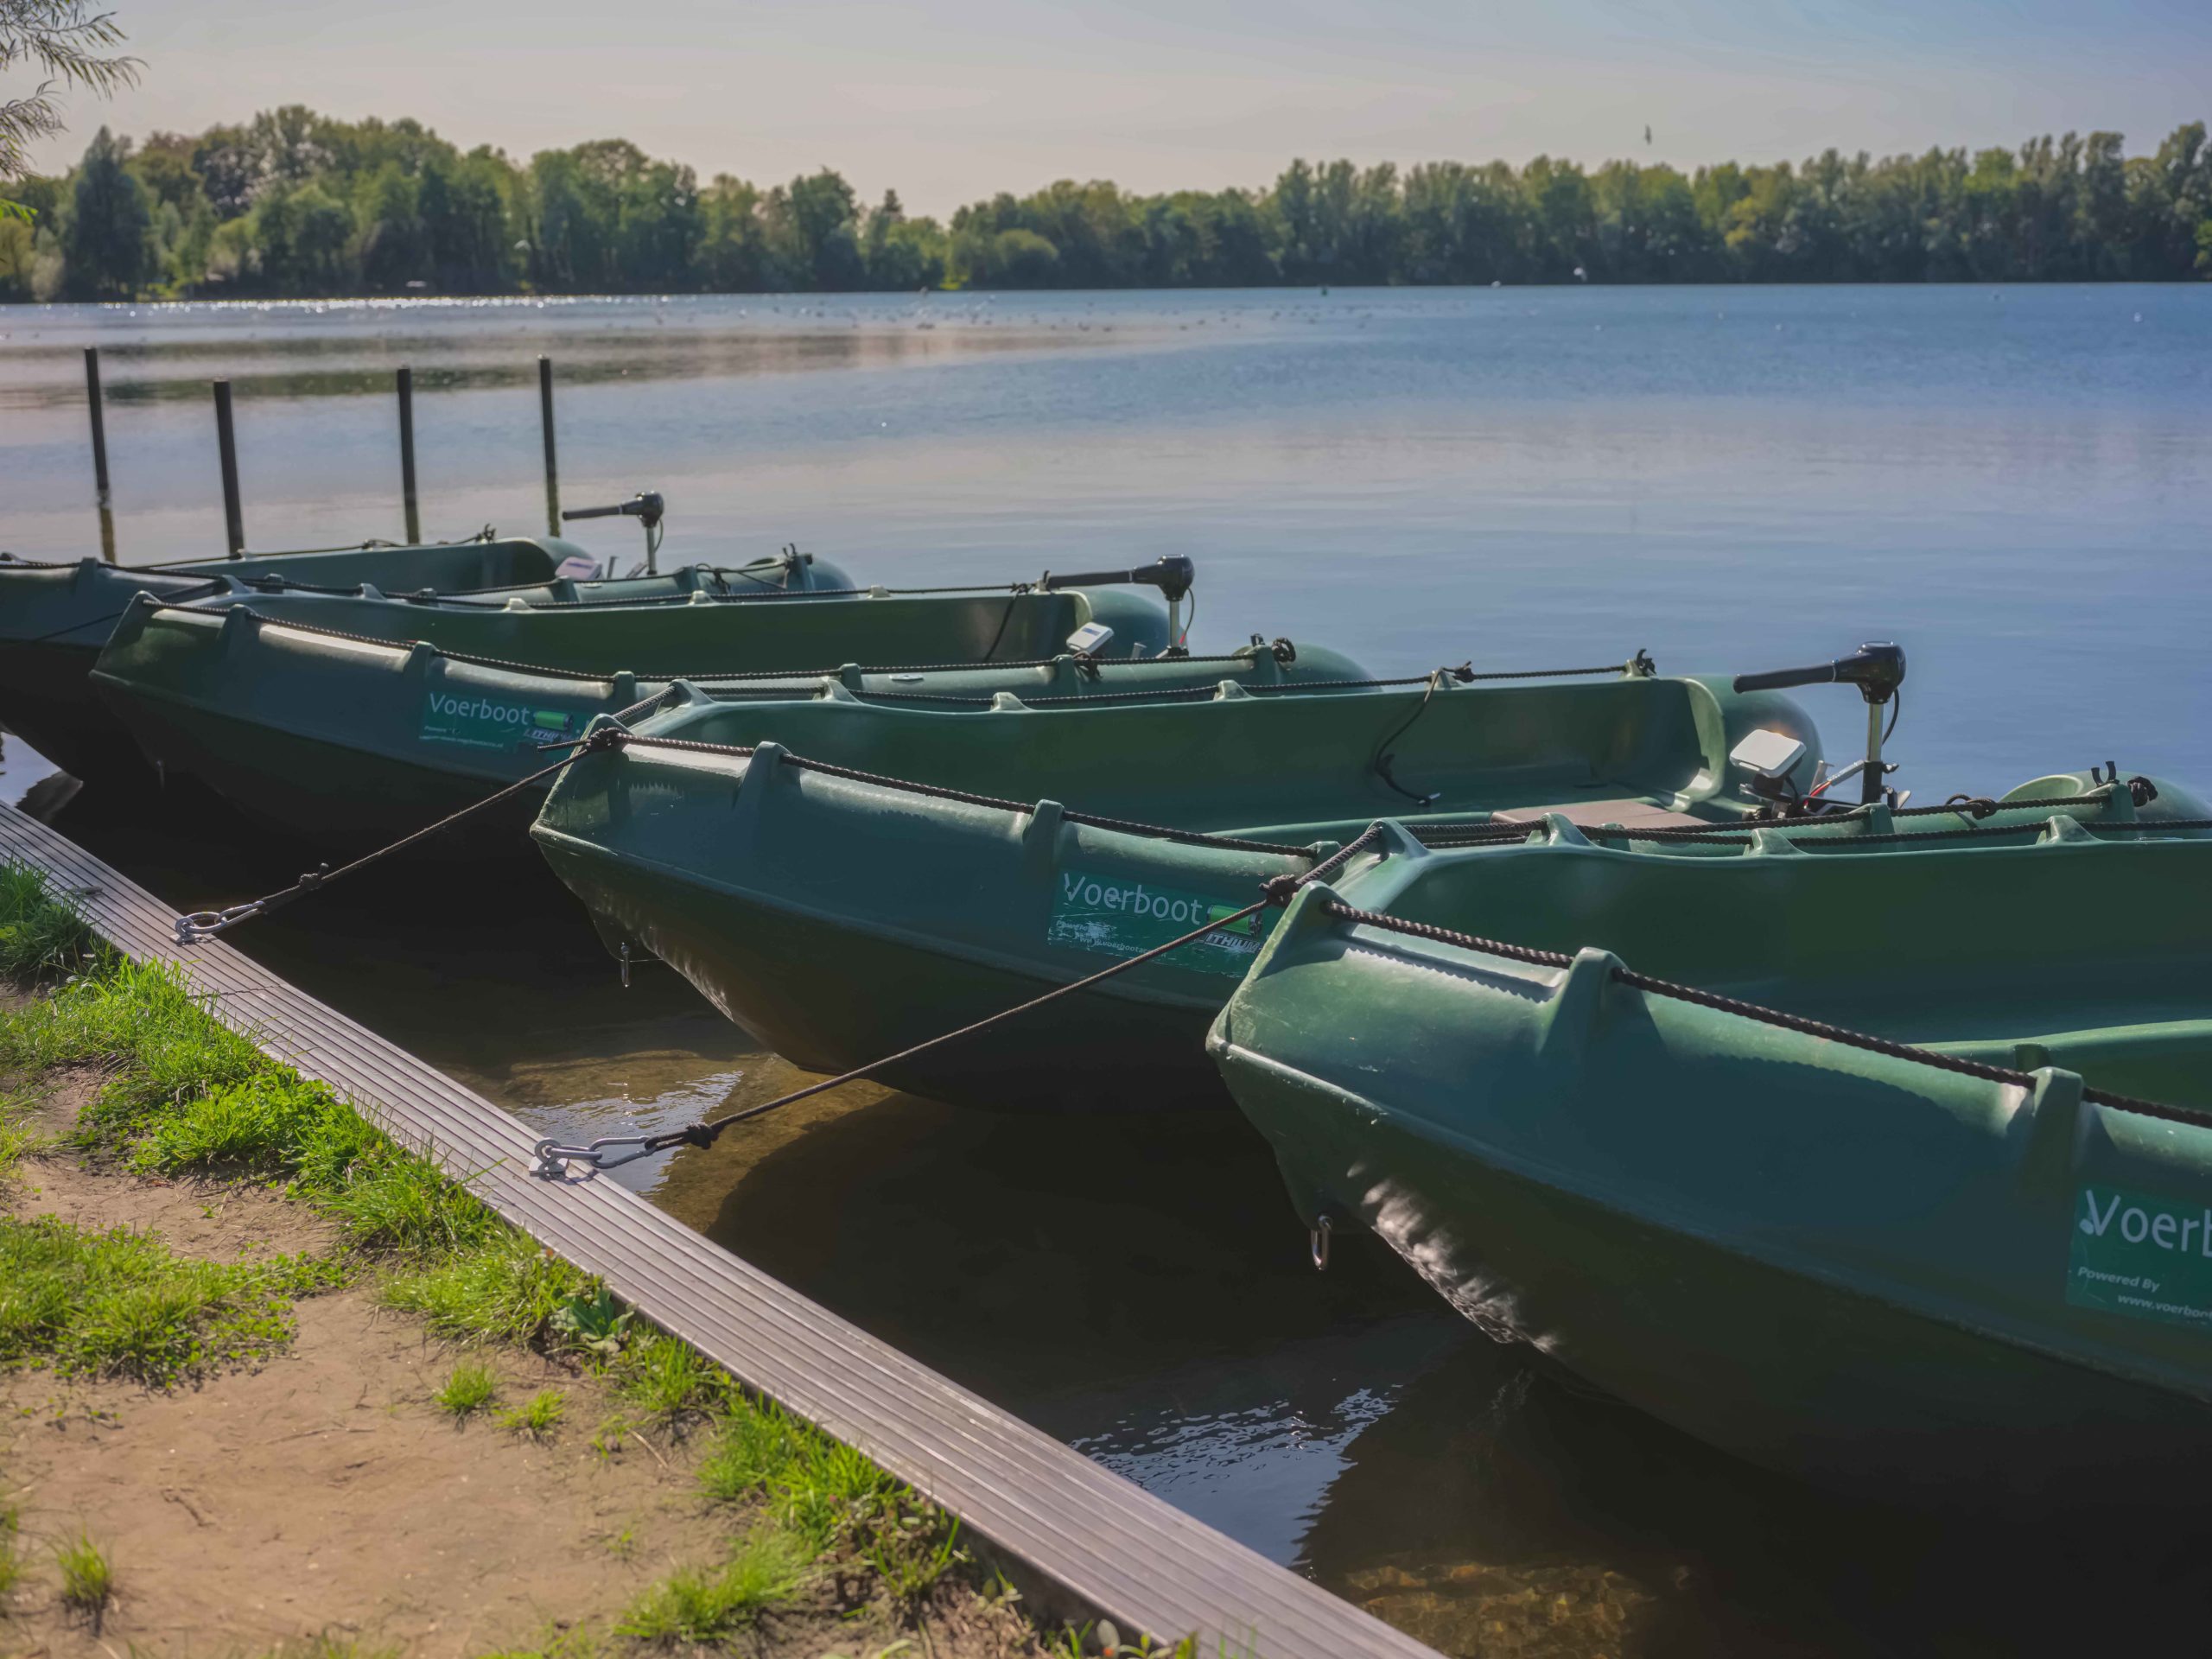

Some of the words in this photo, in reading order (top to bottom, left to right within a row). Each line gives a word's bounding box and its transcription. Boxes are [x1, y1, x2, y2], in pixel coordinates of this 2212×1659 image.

[429, 692, 531, 726] Voerboot
[1064, 873, 1203, 925] Voerboot
[2076, 1266, 2140, 1287] Powered
[2141, 1277, 2160, 1293] By
